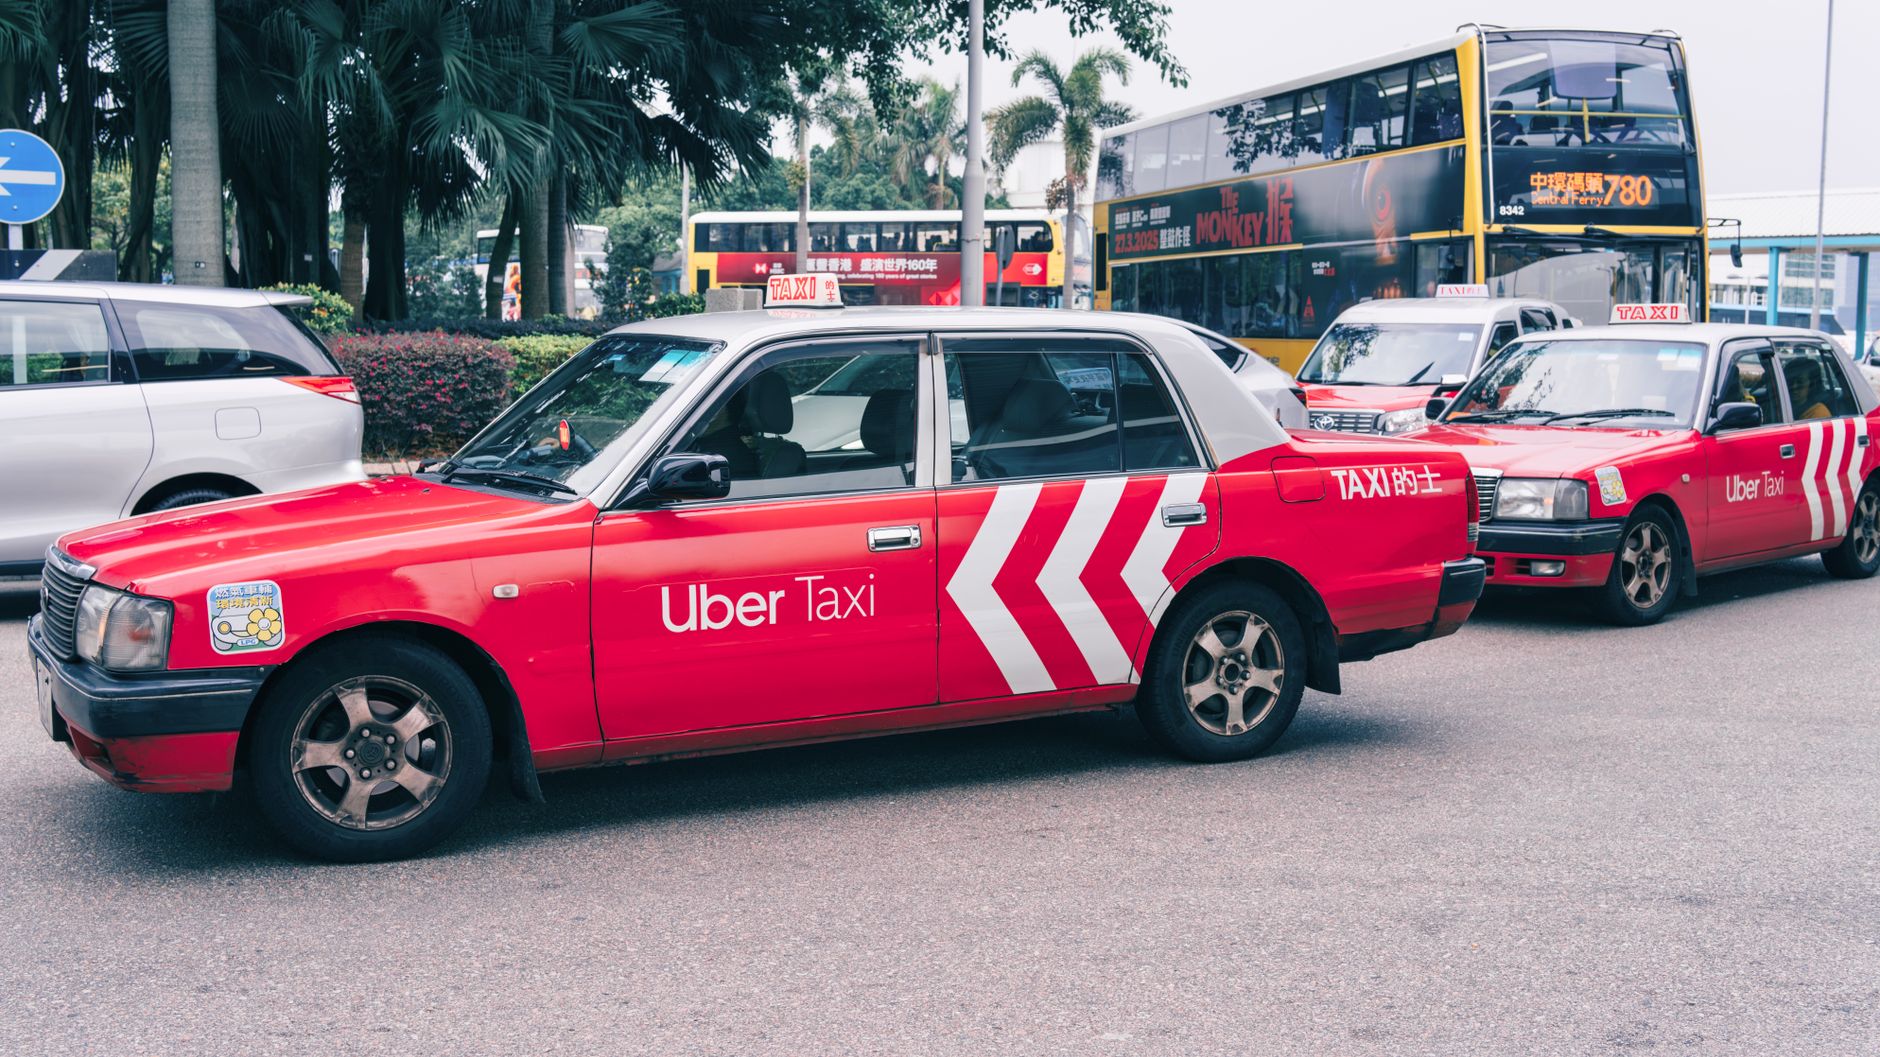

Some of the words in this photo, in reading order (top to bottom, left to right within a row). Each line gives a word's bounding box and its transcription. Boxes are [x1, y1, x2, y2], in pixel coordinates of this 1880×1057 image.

[1530, 172, 1604, 193] 中環碼頭
[1604, 174, 1652, 206] 780
[1266, 177, 1294, 245] 猴
[1499, 205, 1525, 216] 8342
[1571, 191, 1604, 207] Ferry
[1196, 210, 1265, 247] MONKEY
[1115, 229, 1159, 253] 27.3.2025
[770, 276, 817, 300] TAXI
[825, 280, 836, 302] 的士
[1616, 305, 1679, 320] TAXI
[1330, 467, 1391, 500] TAXI
[1391, 464, 1443, 496] 的士
[1726, 474, 1761, 503] Uber
[1761, 470, 1784, 497] Taxi
[661, 583, 786, 633] Uber
[794, 572, 875, 622] Taxi
